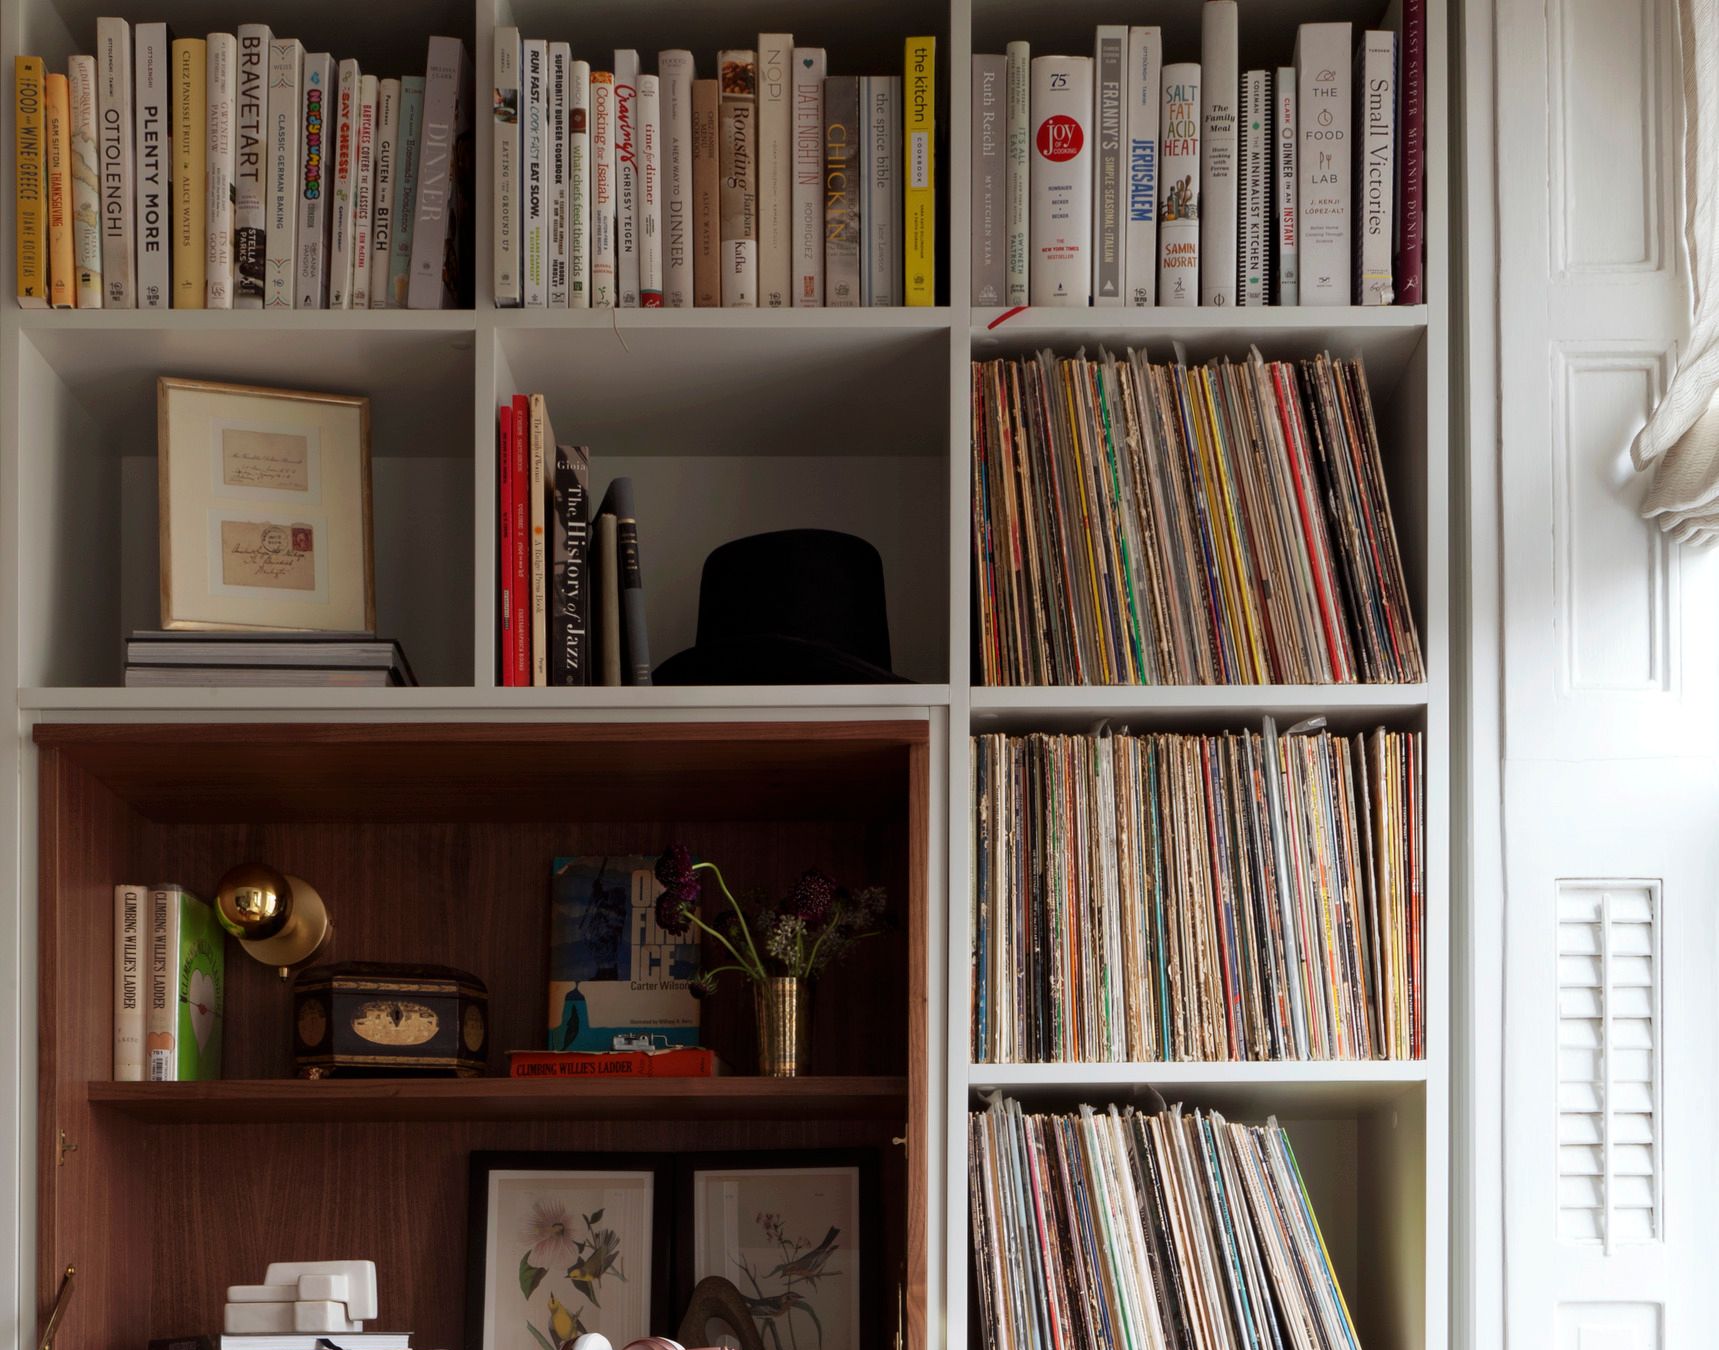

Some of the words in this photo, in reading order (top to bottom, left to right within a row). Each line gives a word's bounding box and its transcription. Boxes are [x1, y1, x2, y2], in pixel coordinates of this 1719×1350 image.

[1409, 19, 1419, 54] LAST
[182, 50, 191, 80] CHEZ
[531, 50, 539, 74] RUN
[767, 49, 782, 102] NOPI
[914, 47, 928, 73] the
[531, 75, 539, 105] FAST.
[554, 53, 563, 108] SUPERIORITY
[983, 71, 995, 106] Ruth
[1050, 73, 1068, 88] 75
[1166, 85, 1198, 104] SALT
[1312, 87, 1338, 97] THE
[1408, 60, 1418, 117] SUPPER
[20, 83, 37, 114] FOOD
[182, 81, 191, 122] PANISSE
[240, 36, 260, 183] BRAVETART
[341, 92, 350, 118] SAY
[594, 86, 609, 146] Cooking
[798, 83, 820, 121] DATE
[876, 93, 889, 116] the
[914, 76, 928, 122] kitchn
[1102, 81, 1119, 150] FRANNY'S
[1168, 103, 1194, 121] FAT
[1369, 79, 1389, 137] Small
[51, 118, 59, 137] SAM
[210, 104, 219, 154] PALTROW
[219, 101, 228, 155] GWYNETH
[277, 113, 286, 152] CLASSIC
[361, 104, 372, 144] BABYCAKES
[529, 106, 539, 134] COOK
[554, 109, 563, 141] BURGER
[613, 84, 639, 178] Cravings
[872, 118, 888, 151] spice
[983, 111, 996, 157] Reichl
[1167, 120, 1196, 139] ACID
[1205, 113, 1236, 122] Family
[1209, 125, 1231, 133] Meal
[20, 127, 37, 157] WINE
[52, 137, 60, 168] SIFTON
[144, 106, 158, 185] PLENTY
[182, 124, 191, 155] FRUIT
[530, 136, 539, 160] FAST
[645, 123, 655, 152] time
[727, 106, 751, 191] Roasting
[798, 125, 820, 168] NIGHT
[1043, 119, 1076, 156] joy
[1164, 138, 1198, 157] HEAT
[1305, 130, 1344, 141] FOOD
[360, 146, 370, 173] COVERS
[380, 140, 391, 184] GLUTEN
[554, 143, 563, 185] COOKBOOK
[572, 144, 583, 172] what
[597, 146, 605, 161] for
[1018, 147, 1026, 166] ALL
[1283, 142, 1293, 178] DINNER
[1407, 127, 1418, 193] MELANIE
[20, 163, 38, 201] GREECE
[105, 109, 122, 238] OTTOLENGHI
[276, 155, 285, 193] GERMAN
[418, 122, 450, 223] DINNER
[530, 162, 539, 183] EAT
[572, 174, 583, 201] chefs
[596, 162, 610, 205] Isaiah
[623, 166, 631, 211] CHRISSY
[645, 164, 656, 206] dinner
[672, 183, 680, 196] TO
[798, 171, 820, 185] IN
[876, 155, 888, 189] bible
[984, 175, 992, 189] MY
[1131, 138, 1154, 222] JERUSALEM
[1251, 151, 1260, 218] MINIMALIST
[1286, 181, 1291, 190] IN
[1311, 174, 1338, 184] LAB
[51, 172, 63, 227] THANKSGIVING
[182, 176, 191, 205] ALICE
[359, 186, 369, 220] CLASSICS
[530, 184, 539, 220] SLOW.
[1286, 192, 1291, 204] AN
[1369, 144, 1389, 236] Victories
[22, 211, 35, 236] DIANE
[145, 194, 159, 253] MORE
[182, 207, 191, 247] WATERS
[276, 195, 284, 229] BAKING
[376, 207, 388, 251] BITCH
[572, 203, 582, 226] feed
[742, 193, 755, 237] Barbara
[984, 193, 992, 237] KITCHEN
[1283, 207, 1294, 247] INSTANT
[1407, 199, 1417, 251] DUNEA
[239, 231, 247, 262] PARKS
[247, 228, 256, 264] STELLA
[502, 239, 509, 252] UP
[572, 227, 583, 253] their
[623, 215, 632, 253] TEIGEN
[669, 199, 684, 269] DINNER
[803, 202, 813, 260] RODRIGUEZ
[878, 223, 887, 240] Jane
[1164, 242, 1196, 255] SAMIN
[1250, 223, 1260, 270] KITCHEN
[219, 249, 227, 266] ALL
[572, 255, 583, 277] kids
[734, 240, 746, 274] Kafka
[1009, 233, 1017, 273] PALTROW
[1163, 257, 1197, 269] NOSRAT
[556, 460, 587, 471] Gioia
[568, 484, 583, 516] The
[561, 521, 586, 600] History
[535, 595, 543, 614] Book
[562, 602, 581, 623] of
[566, 623, 586, 670] Jazz
[124, 892, 137, 933] CLIMBING
[153, 892, 167, 933] CLIMBING
[123, 935, 137, 972] WILLIE'S
[152, 935, 166, 972] WILLIE'S
[630, 944, 676, 981] ICE
[123, 974, 136, 1010] LADDER
[152, 974, 166, 1010] LADDER
[630, 981, 658, 991] Carter
[516, 1062, 558, 1077] CLIMBING
[559, 1062, 595, 1075] WILLIE'S
[597, 1060, 633, 1074] LADDER
